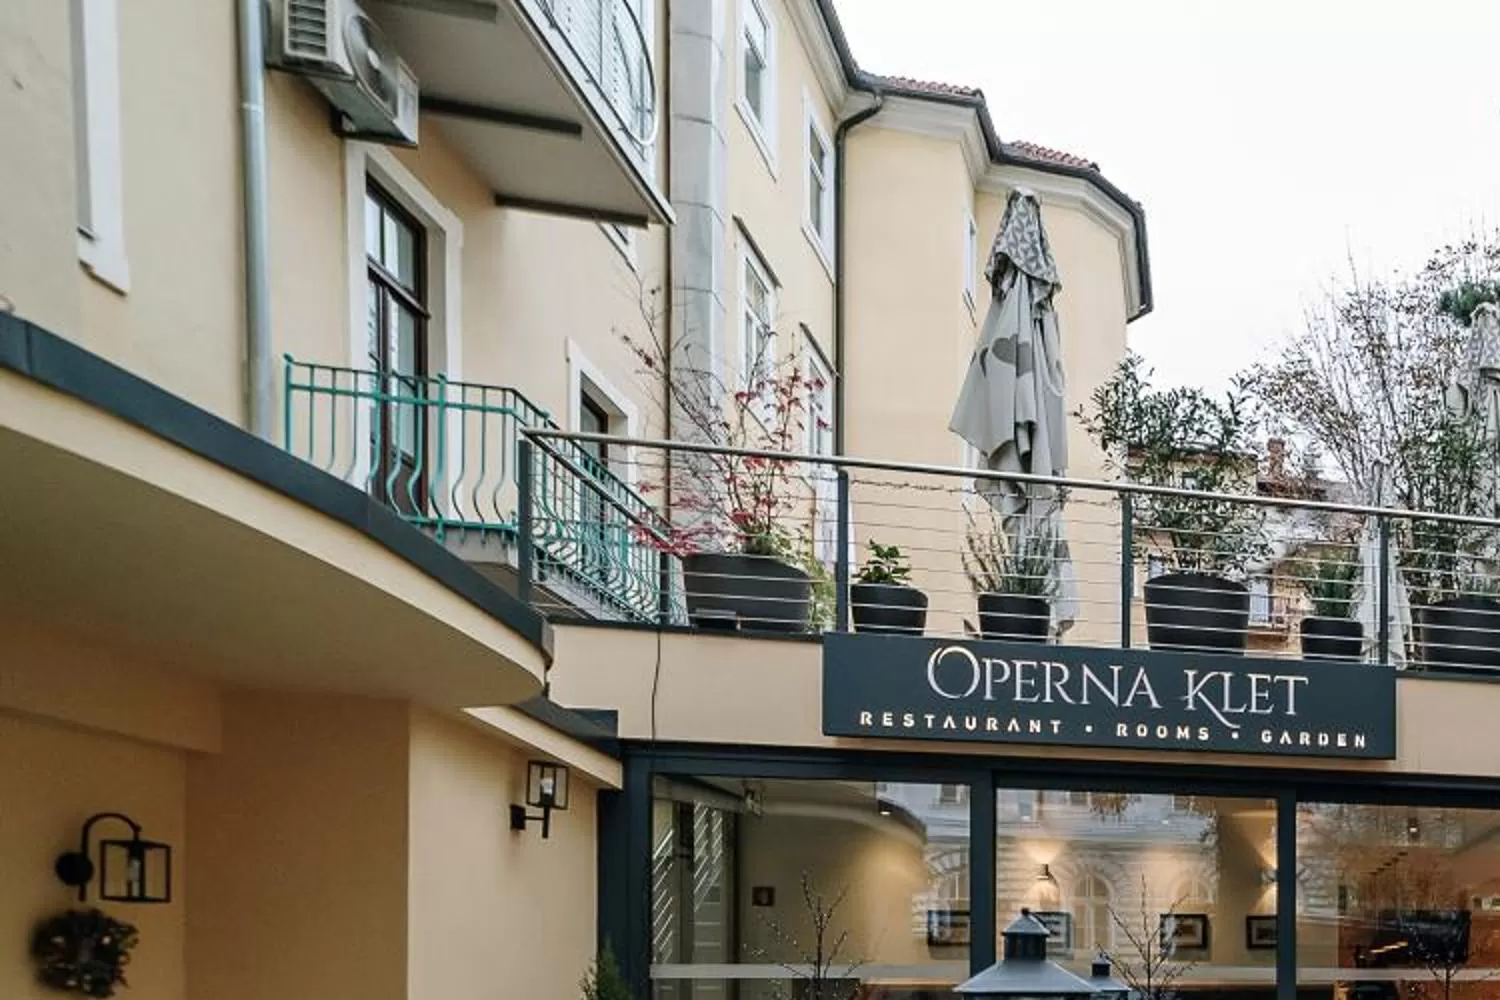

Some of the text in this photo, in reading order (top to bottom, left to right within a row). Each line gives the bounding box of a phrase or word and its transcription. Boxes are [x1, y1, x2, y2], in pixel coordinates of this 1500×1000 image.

[926, 646, 1309, 728] OPERNA KLET
[859, 711, 1367, 748] RESTAURANT ROOMS GARDEN
